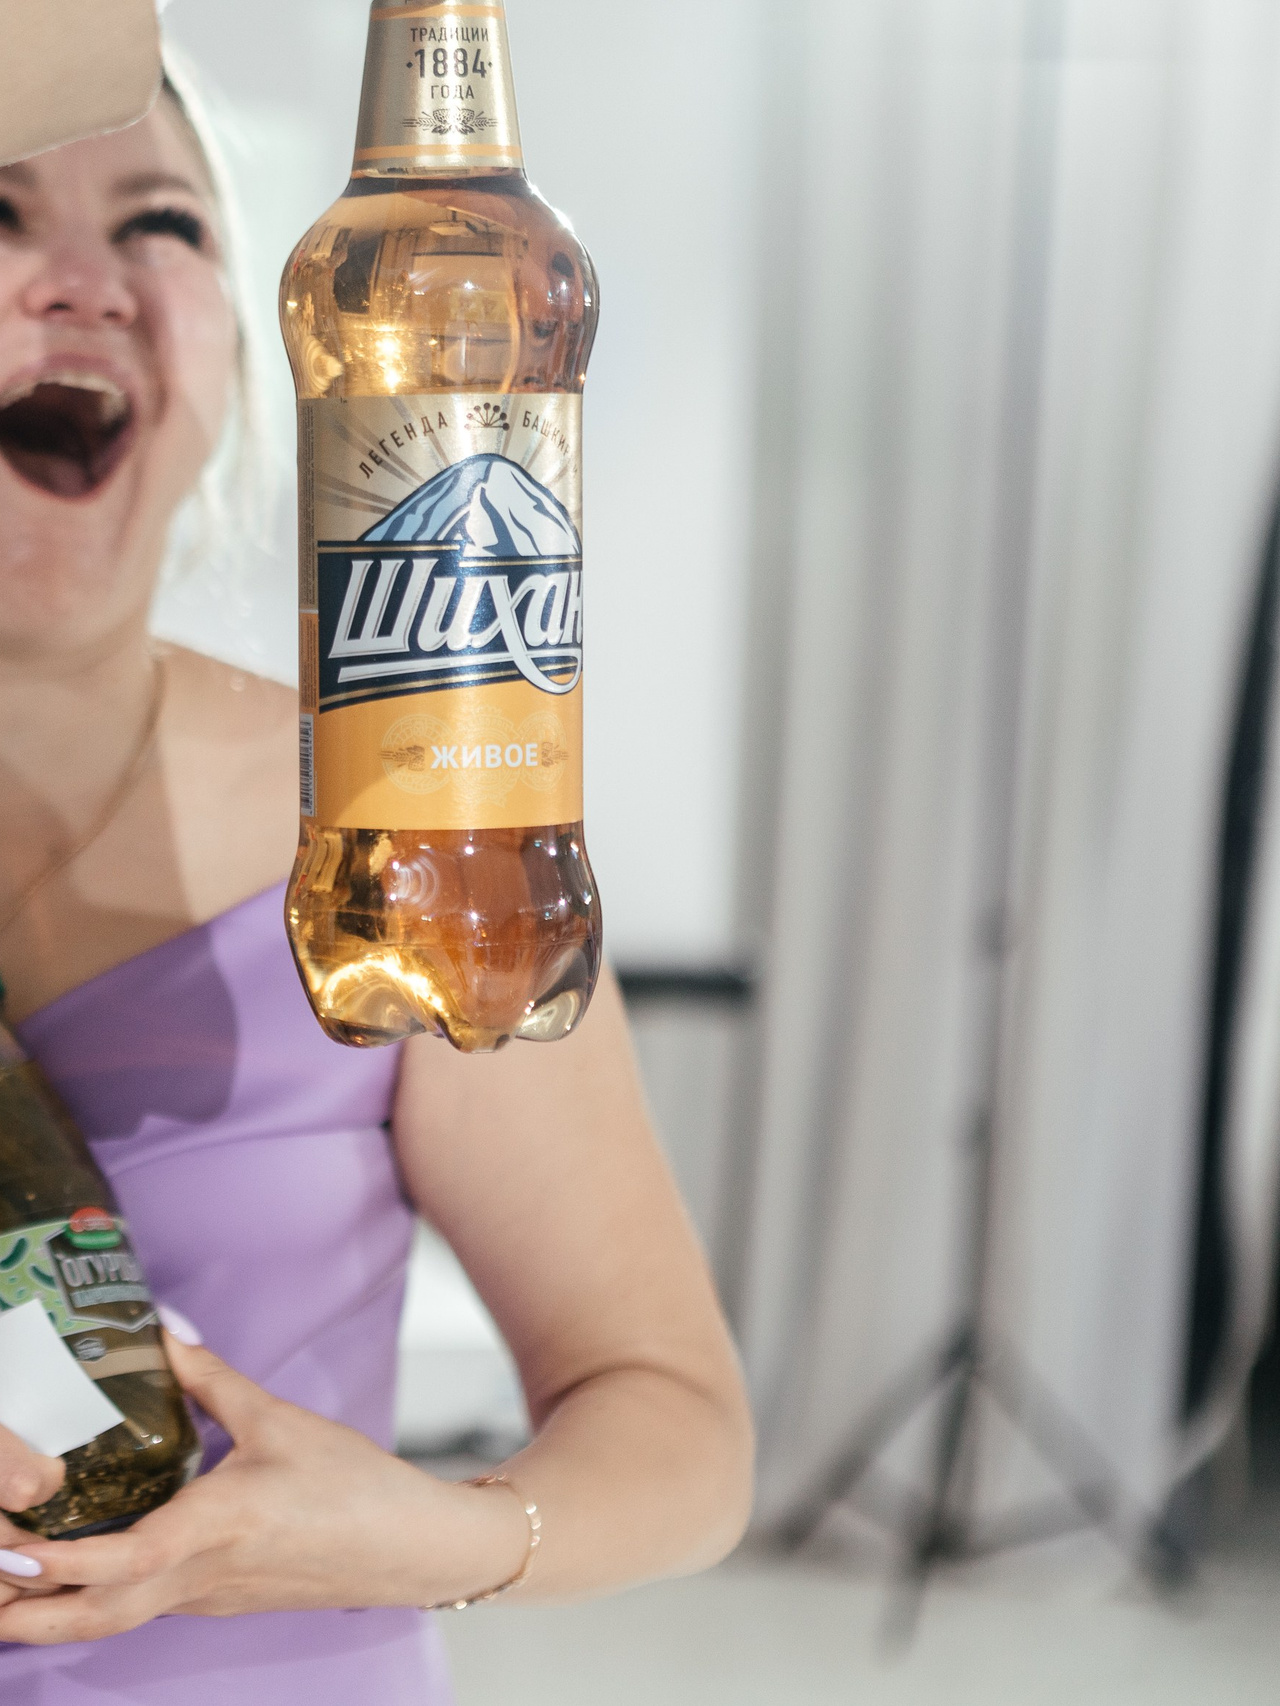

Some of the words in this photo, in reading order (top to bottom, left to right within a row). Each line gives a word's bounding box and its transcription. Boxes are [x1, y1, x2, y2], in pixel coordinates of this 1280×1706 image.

[410, 26, 489, 43] ТРАДИЦИИ
[430, 85, 475, 100] ГОДА
[356, 410, 449, 480] ЛЕГЕНДА
[430, 743, 539, 771] ЖИВОЕ
